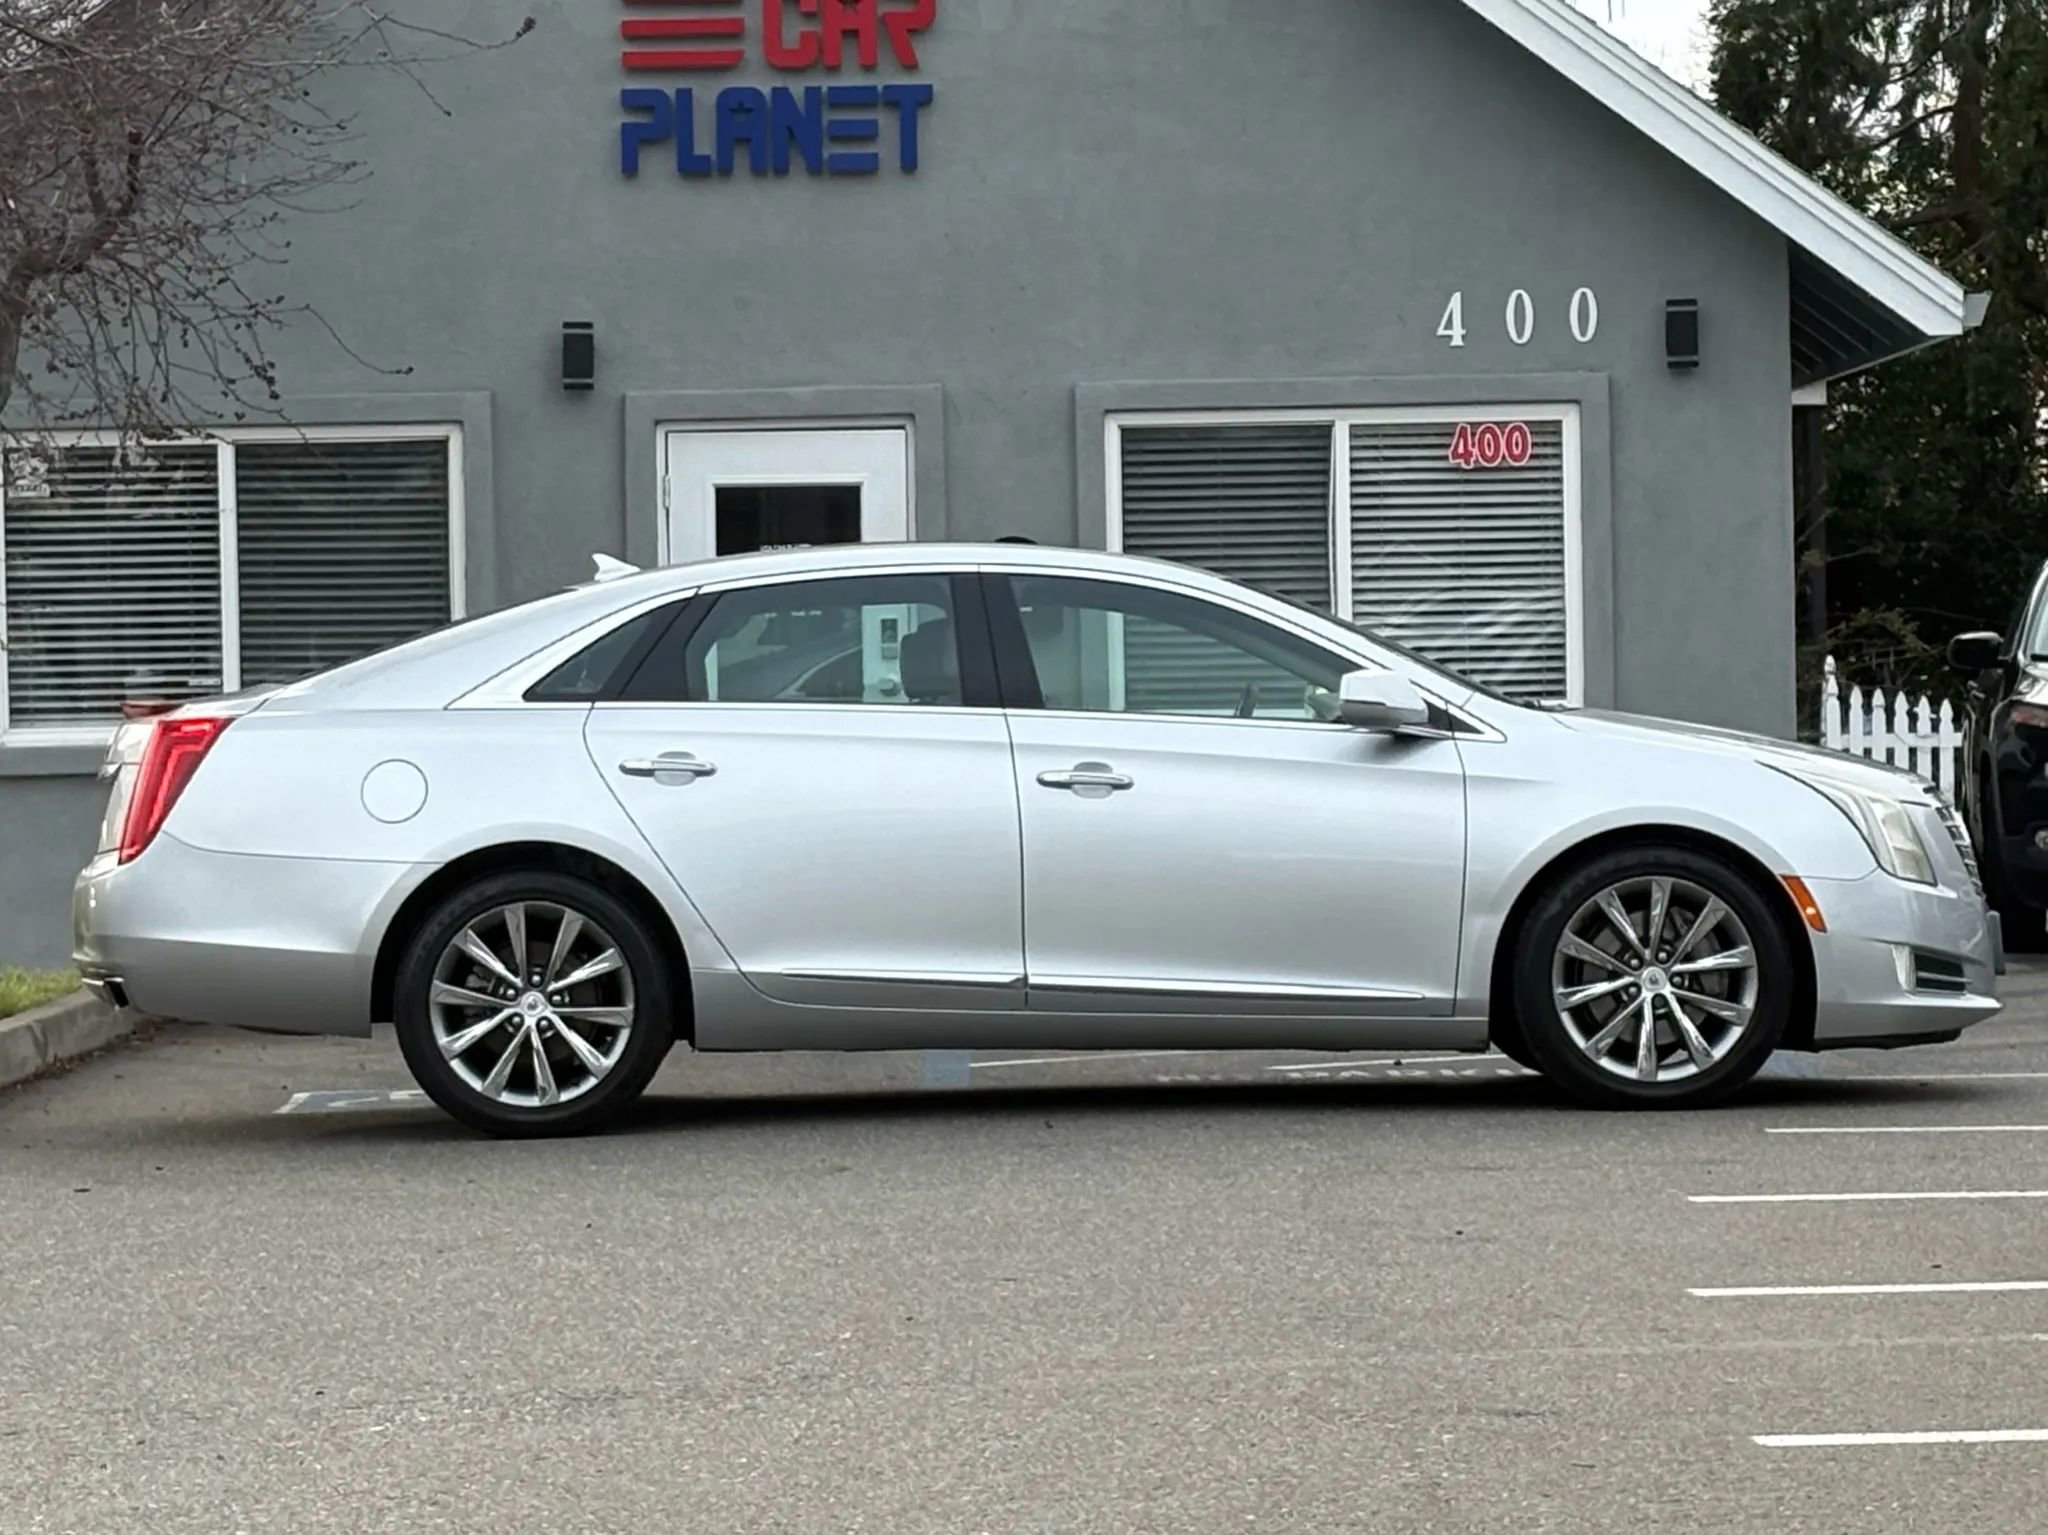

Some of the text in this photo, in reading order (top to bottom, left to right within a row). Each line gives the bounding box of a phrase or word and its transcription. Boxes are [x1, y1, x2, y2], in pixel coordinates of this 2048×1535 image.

[762, 0, 936, 69] CAR
[620, 84, 934, 176] PLANET
[1436, 287, 1598, 346] 400
[1449, 422, 1532, 469] 400
